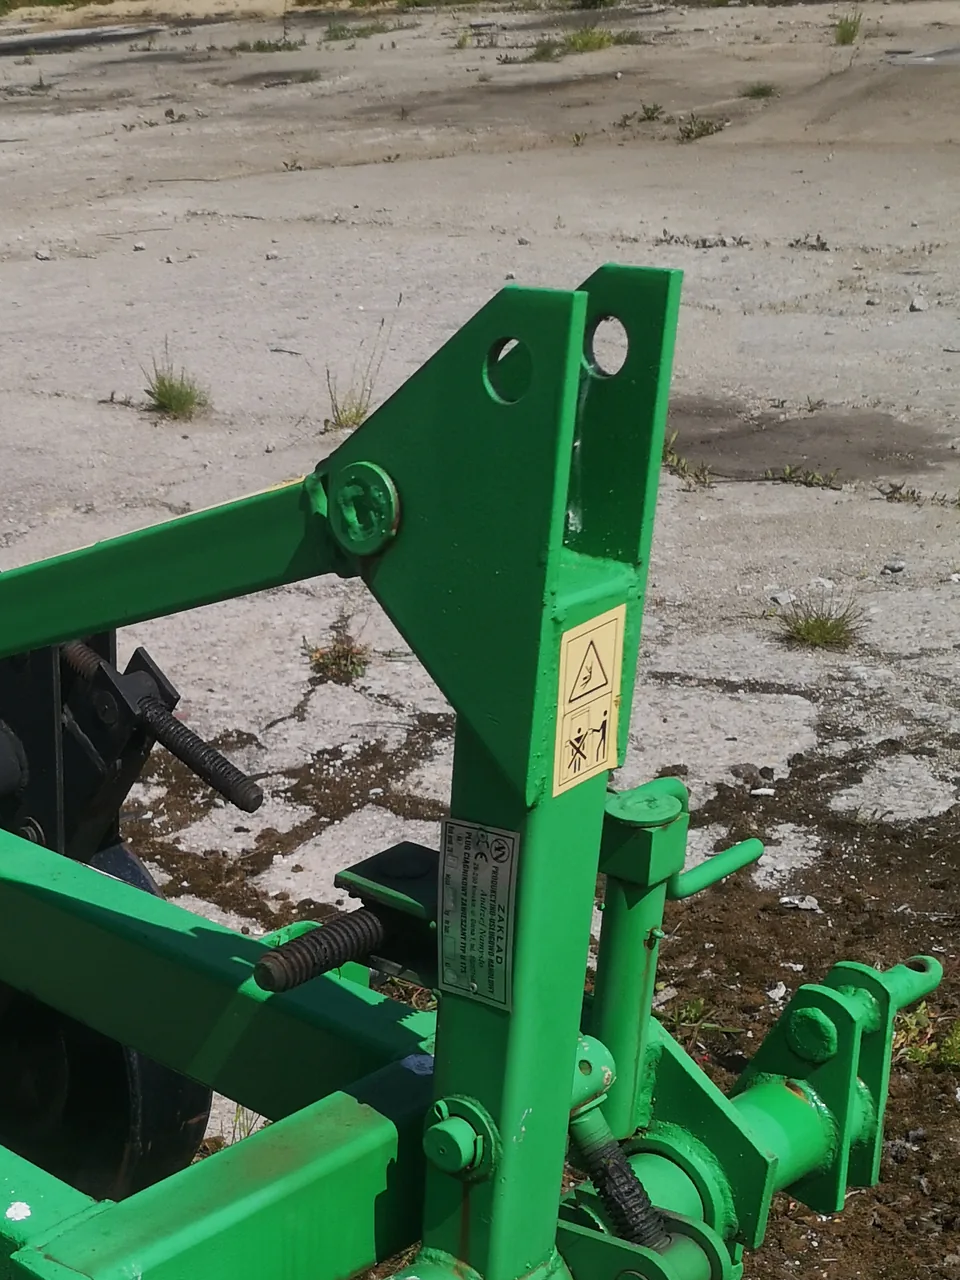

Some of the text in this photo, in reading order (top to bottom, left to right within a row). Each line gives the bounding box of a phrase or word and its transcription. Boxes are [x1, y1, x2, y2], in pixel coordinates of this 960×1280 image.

[464, 831, 472, 851] PŁUG
[478, 889, 487, 926] Andrzej
[495, 903, 505, 964] ZAKŁAD
